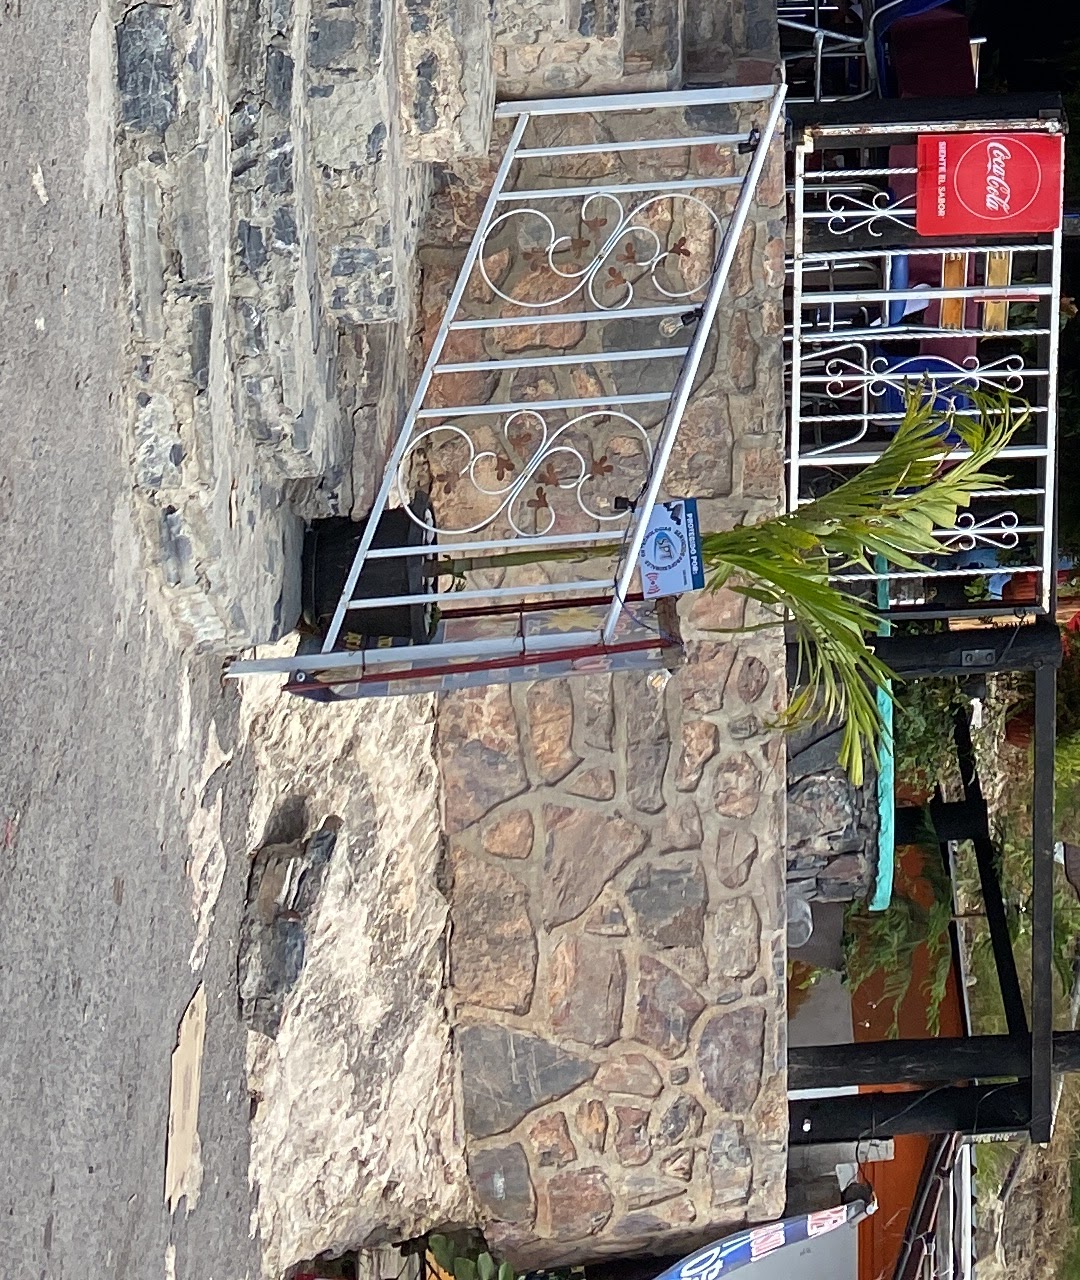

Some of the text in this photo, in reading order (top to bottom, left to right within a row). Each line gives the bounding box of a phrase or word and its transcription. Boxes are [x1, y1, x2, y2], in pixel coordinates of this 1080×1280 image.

[937, 141, 946, 217] SIENTE EL SABOR
[985, 142, 1011, 215] Coca-Cola
